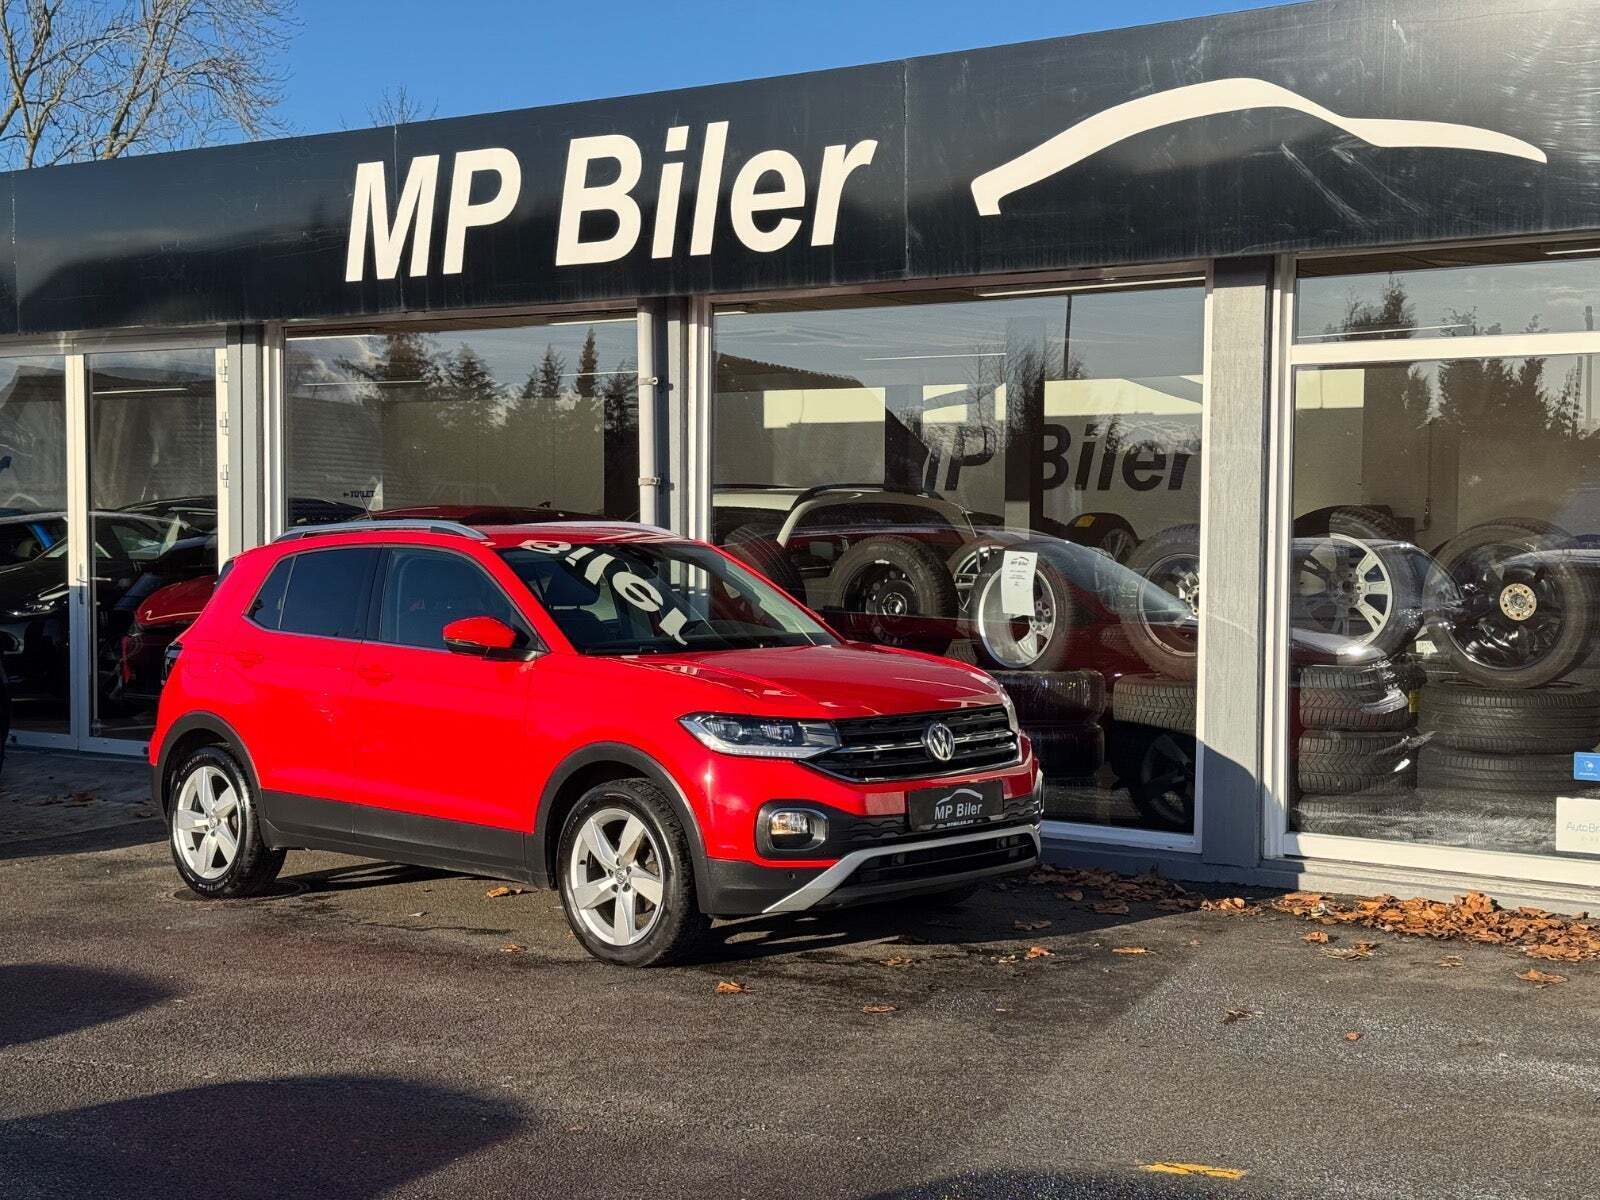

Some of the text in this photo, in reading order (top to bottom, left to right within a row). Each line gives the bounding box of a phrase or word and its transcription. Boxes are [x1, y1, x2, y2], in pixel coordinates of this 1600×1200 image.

[345, 121, 878, 282] MP Biler
[934, 802, 983, 820] MP Biler
